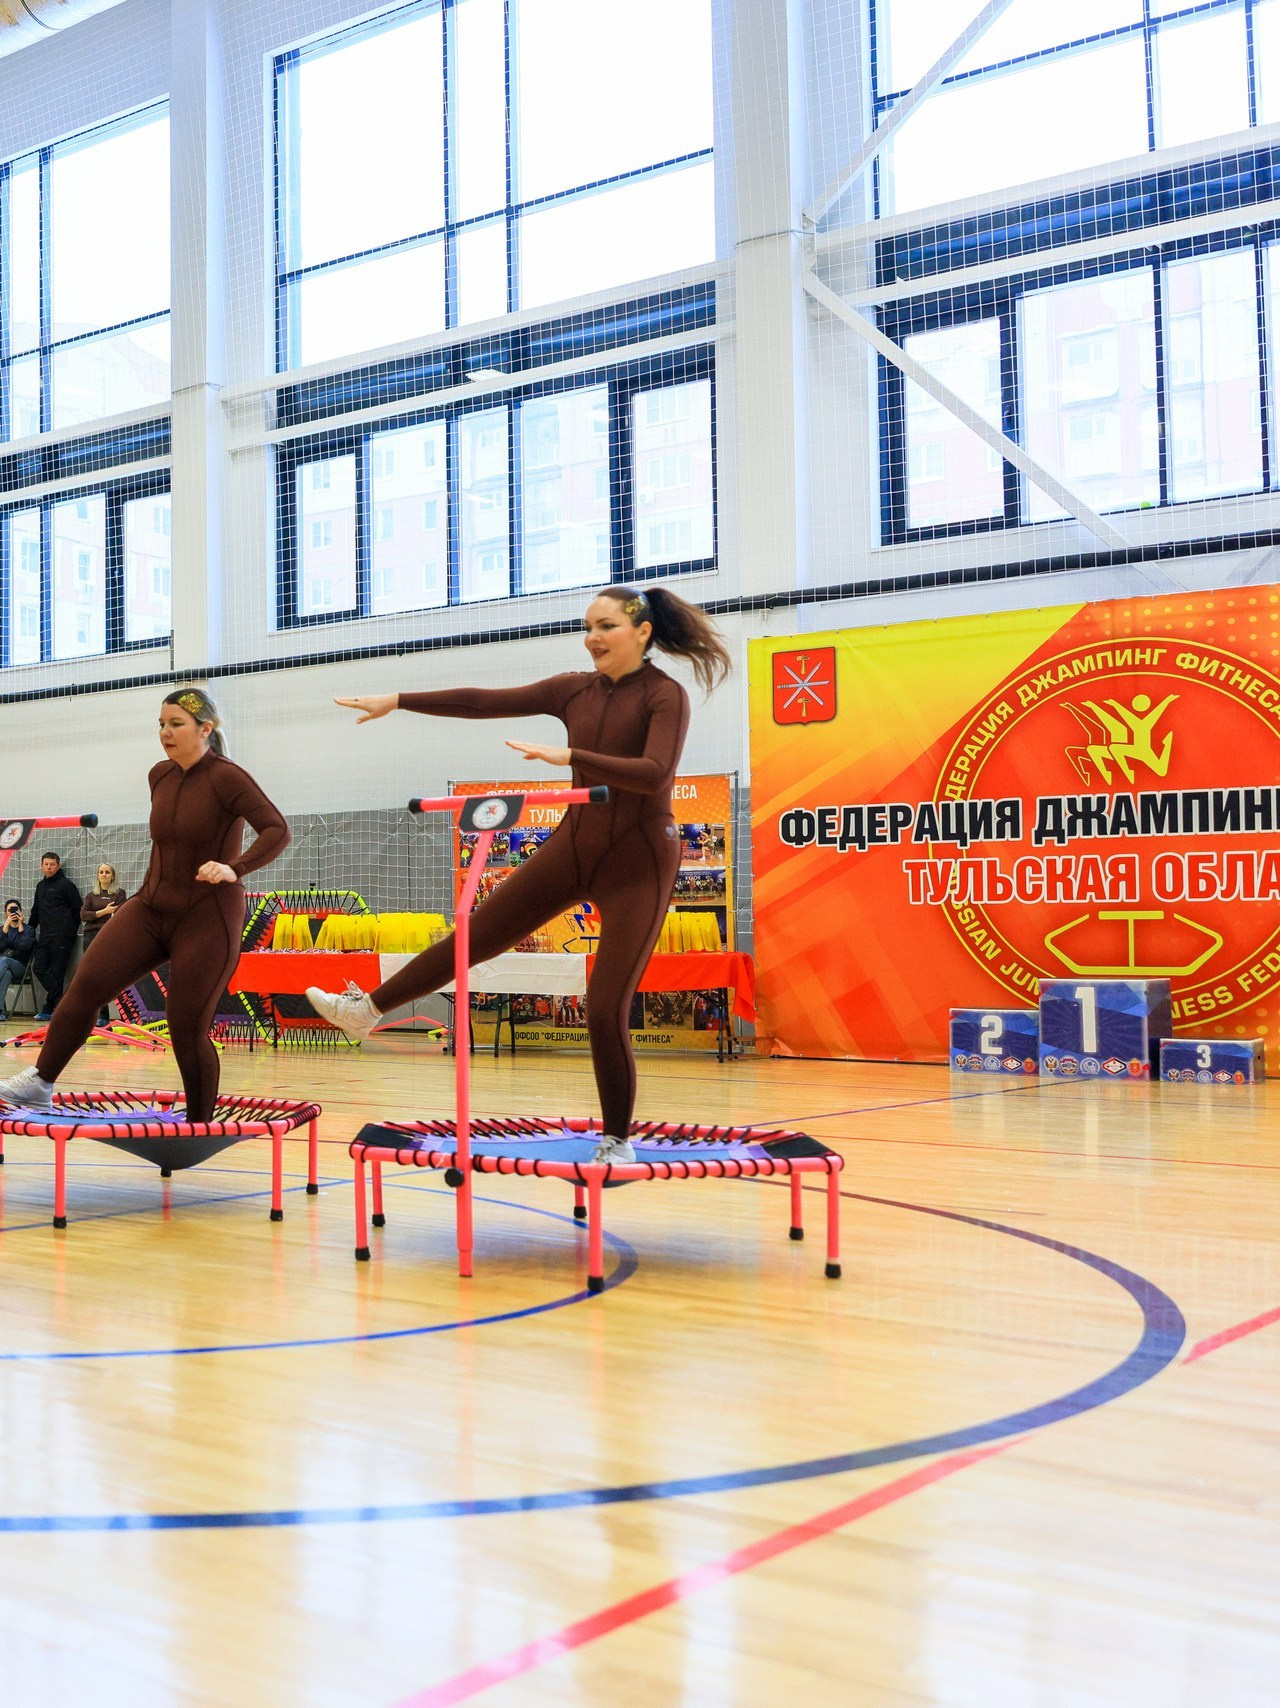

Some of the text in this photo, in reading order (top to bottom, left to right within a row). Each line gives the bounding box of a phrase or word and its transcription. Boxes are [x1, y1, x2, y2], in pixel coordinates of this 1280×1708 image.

[1016, 648, 1167, 707] ДЖАМПИНГ
[671, 784, 698, 800] ЕСА
[780, 787, 1280, 851] ФЕДЕРАЦИЯ ДЖАМПИН
[903, 850, 1280, 904] ТУЛЬСКАЯ ОБЛА
[1236, 944, 1280, 992] FED
[981, 1015, 1003, 1055] 2
[1075, 987, 1096, 1053] 1
[1197, 1044, 1211, 1068] 3
